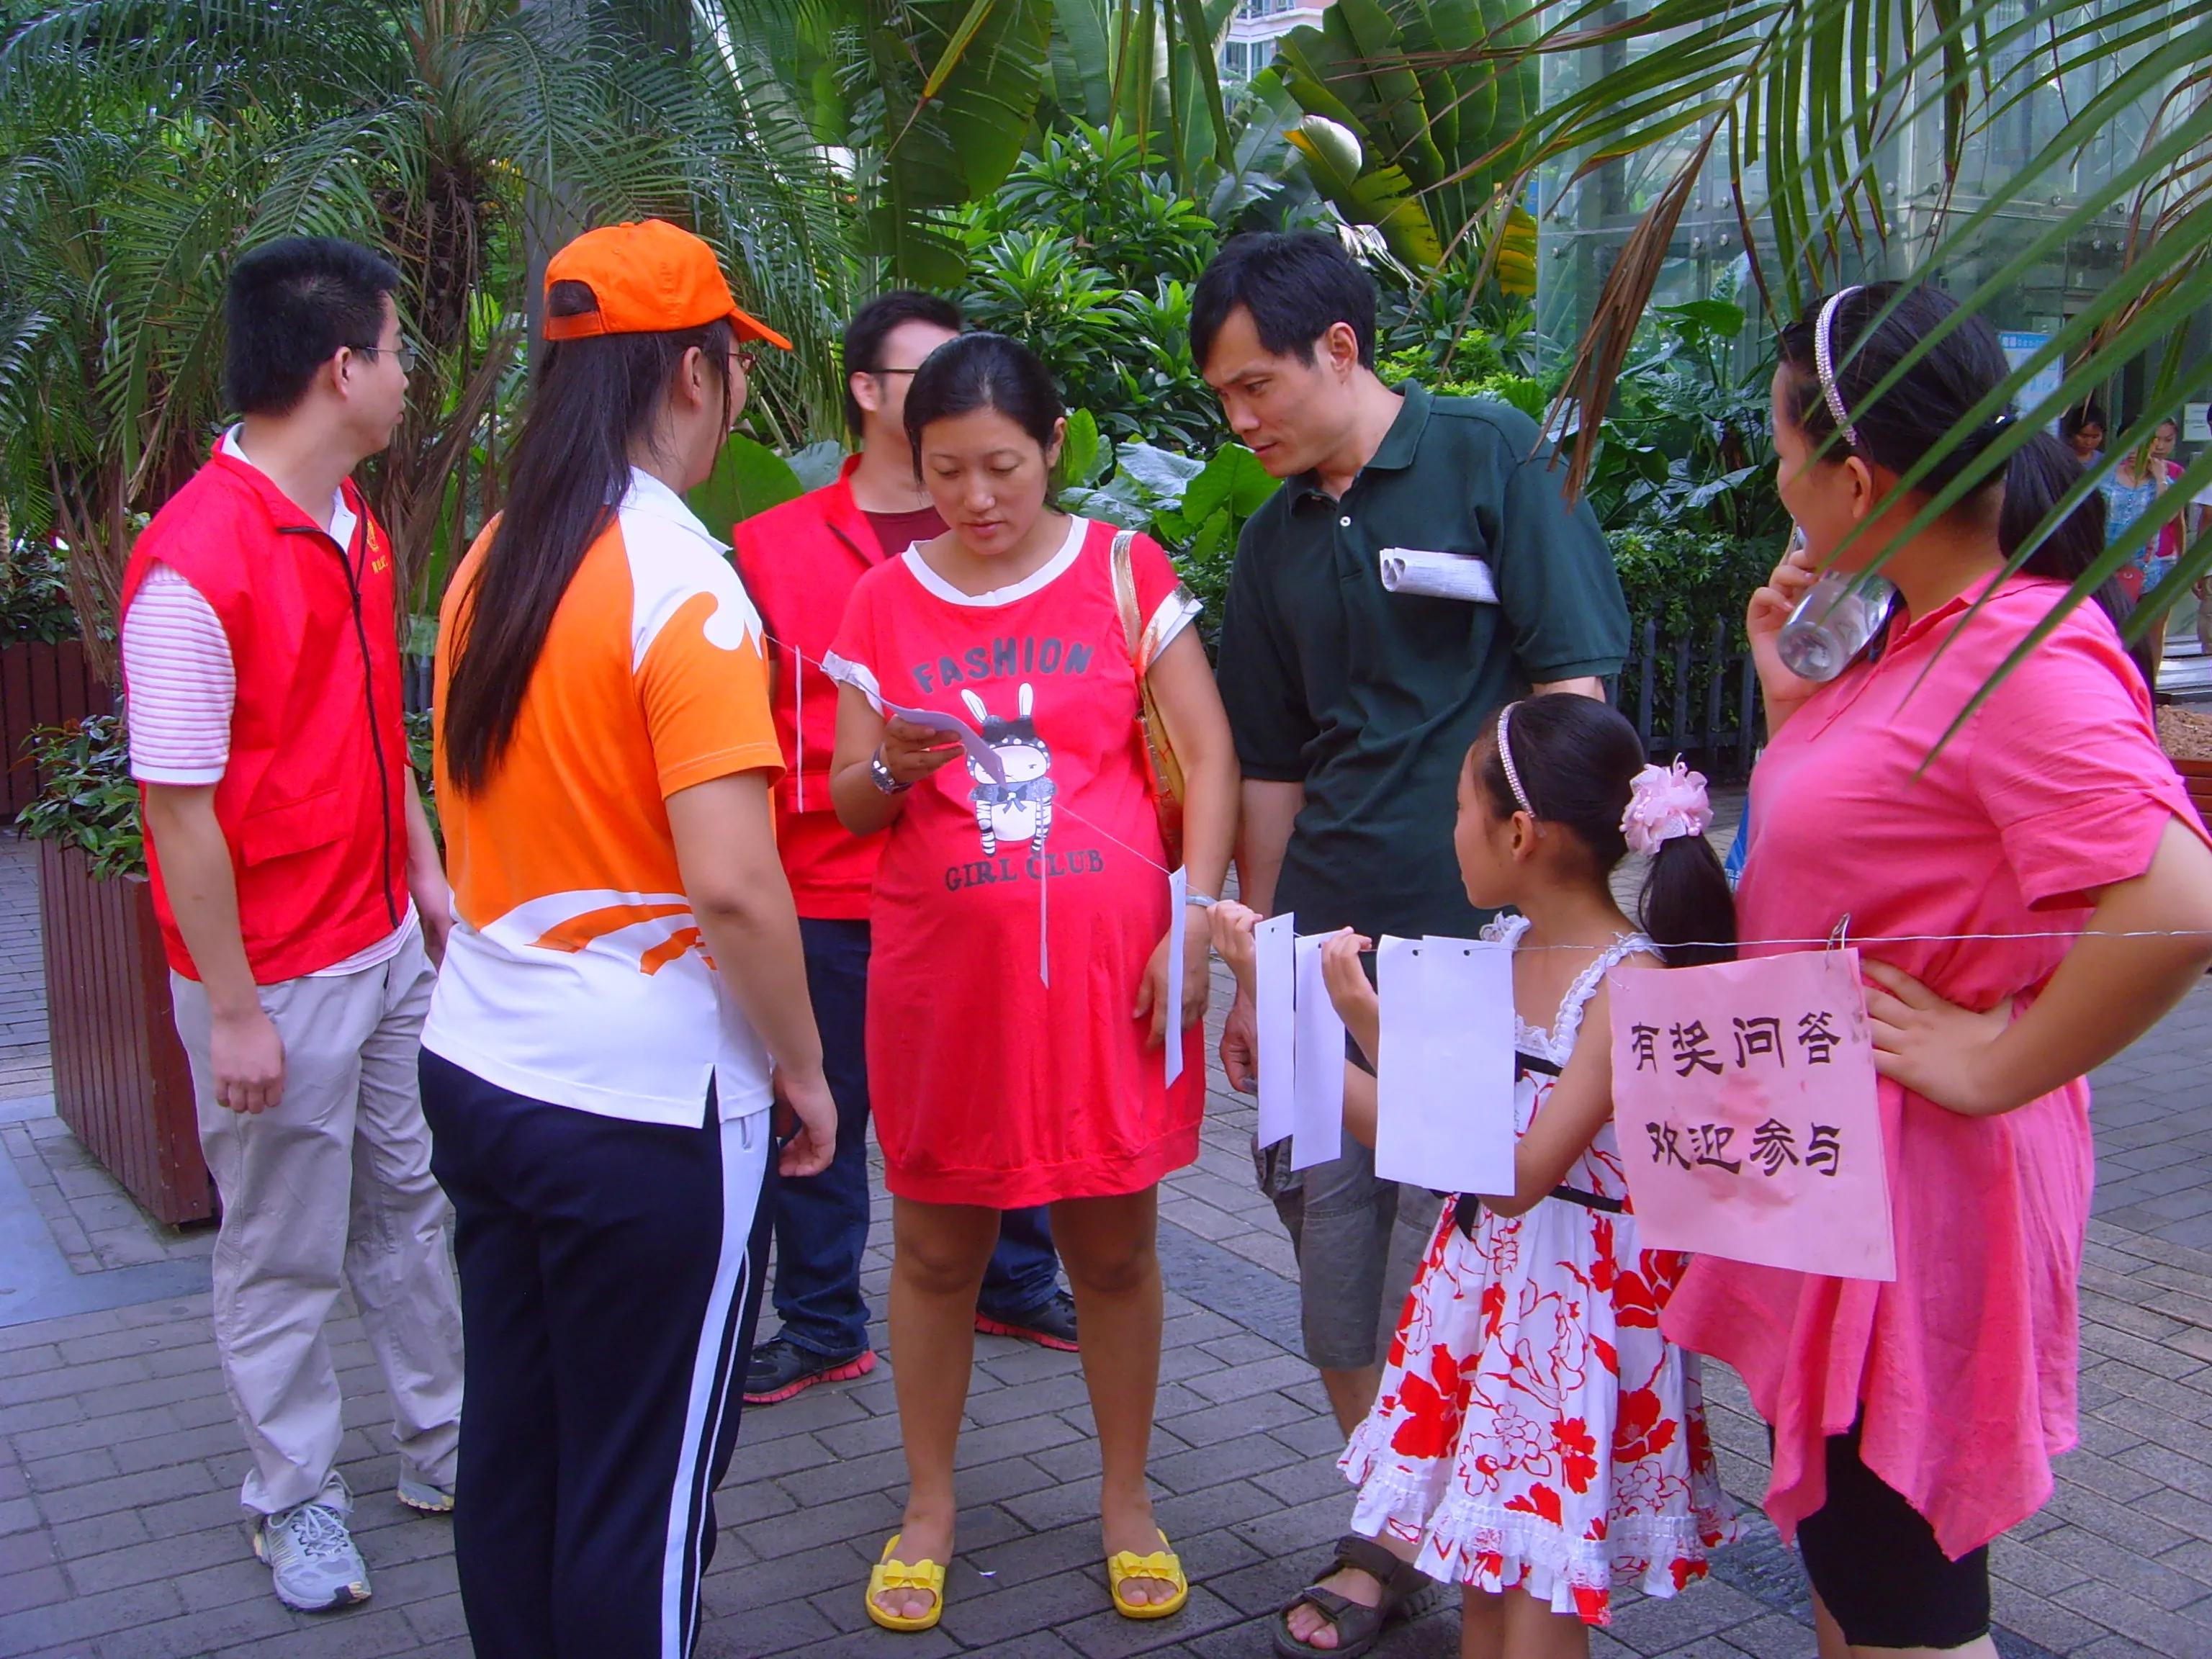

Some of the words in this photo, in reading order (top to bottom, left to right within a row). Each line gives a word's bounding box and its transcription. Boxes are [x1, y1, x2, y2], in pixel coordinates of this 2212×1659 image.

[912, 637, 1094, 693] FASHION
[945, 860, 1017, 892] GIRL
[1025, 850, 1104, 880] CLUB
[1631, 1011, 1840, 1077] 有奖问答
[1645, 1118, 1840, 1177] 欢迎参与
